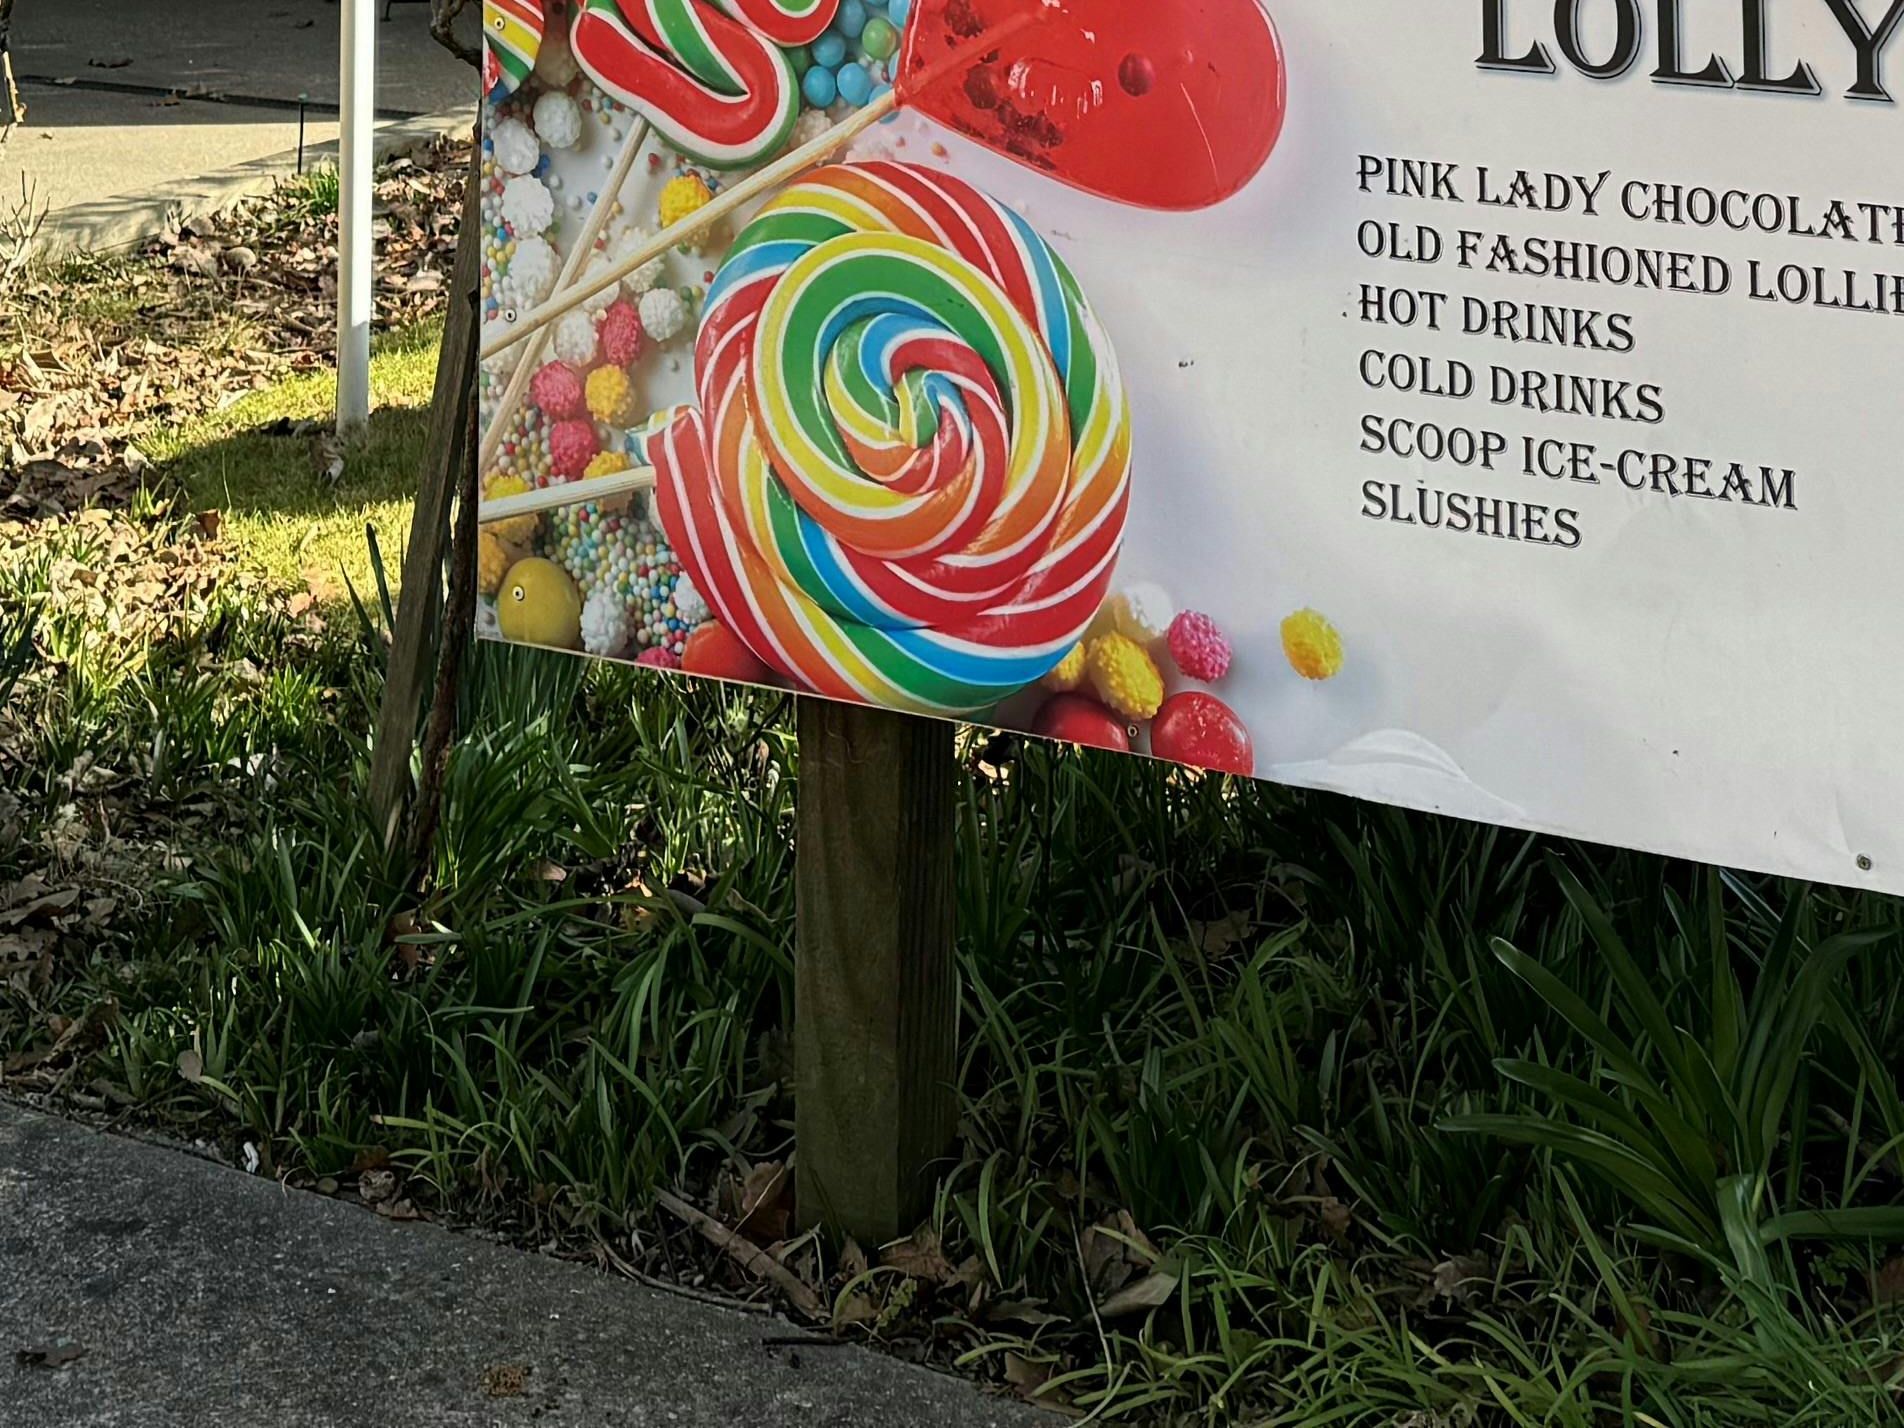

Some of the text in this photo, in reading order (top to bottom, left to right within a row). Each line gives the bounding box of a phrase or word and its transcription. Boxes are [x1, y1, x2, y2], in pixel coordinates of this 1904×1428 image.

[1356, 155, 1463, 202] PINK
[1477, 166, 1611, 216] LADY
[1357, 220, 1443, 263] OLD
[1457, 231, 1731, 295] FASHIONED
[1359, 284, 1636, 352] HOT DRINKS
[1360, 350, 1665, 423] COLD DRINKS
[1360, 415, 1798, 510] SCOOP ICE-CREAM
[1361, 481, 1582, 548] SLUSHIES
